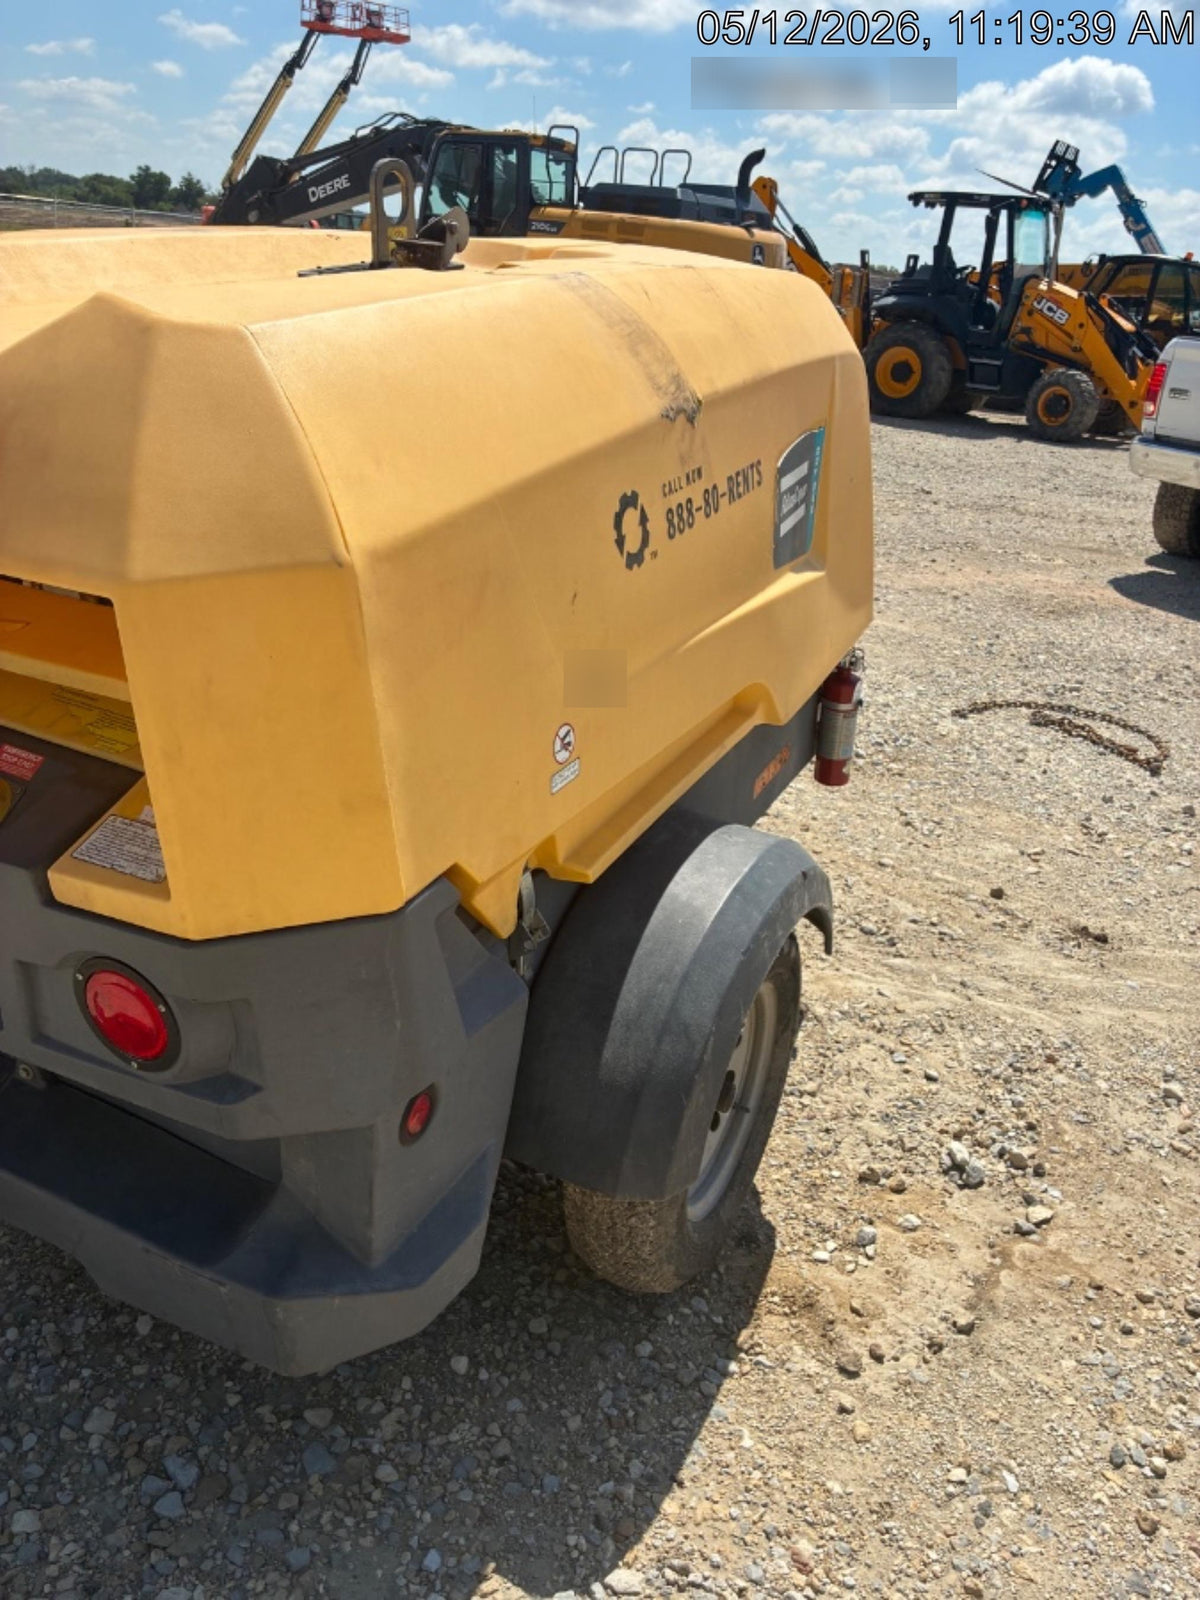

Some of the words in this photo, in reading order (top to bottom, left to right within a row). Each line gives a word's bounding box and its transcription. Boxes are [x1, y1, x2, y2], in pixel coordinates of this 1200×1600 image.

[307, 173, 351, 203] DEERE
[1033, 297, 1070, 325] JCB
[662, 475, 684, 497] CALL
[685, 466, 703, 487] NOW
[665, 459, 763, 541] 888-80-RENTS
